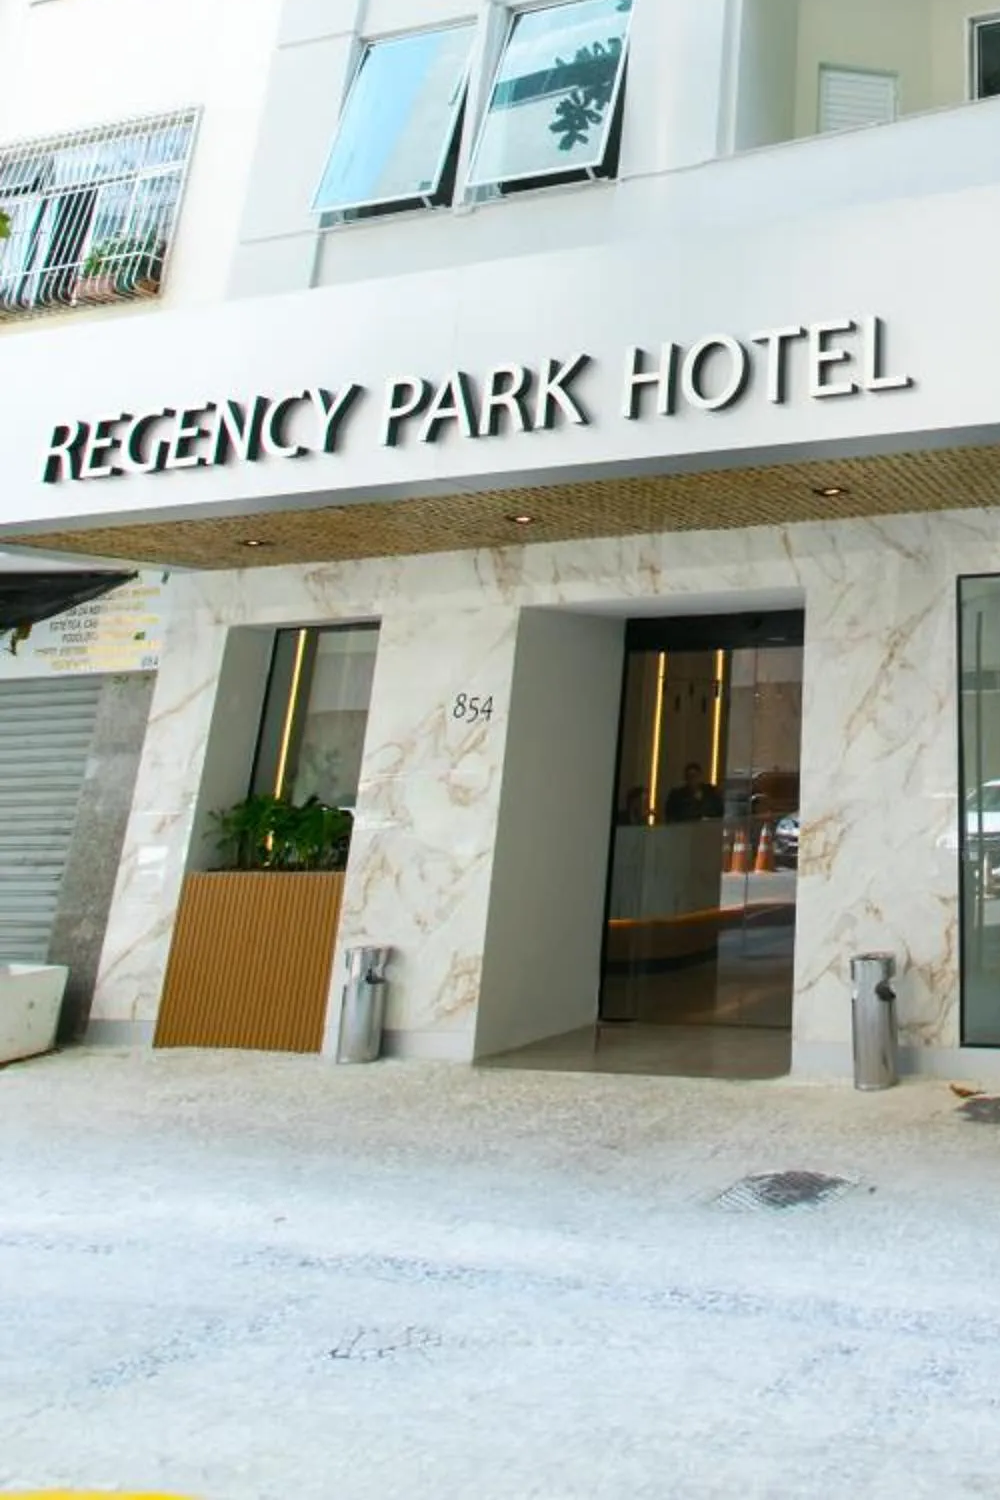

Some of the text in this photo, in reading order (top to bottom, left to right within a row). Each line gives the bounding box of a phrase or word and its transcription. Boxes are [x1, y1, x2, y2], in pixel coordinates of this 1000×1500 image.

[43, 315, 914, 484] REGENCY PARK HOTEL
[453, 693, 493, 723] 854
